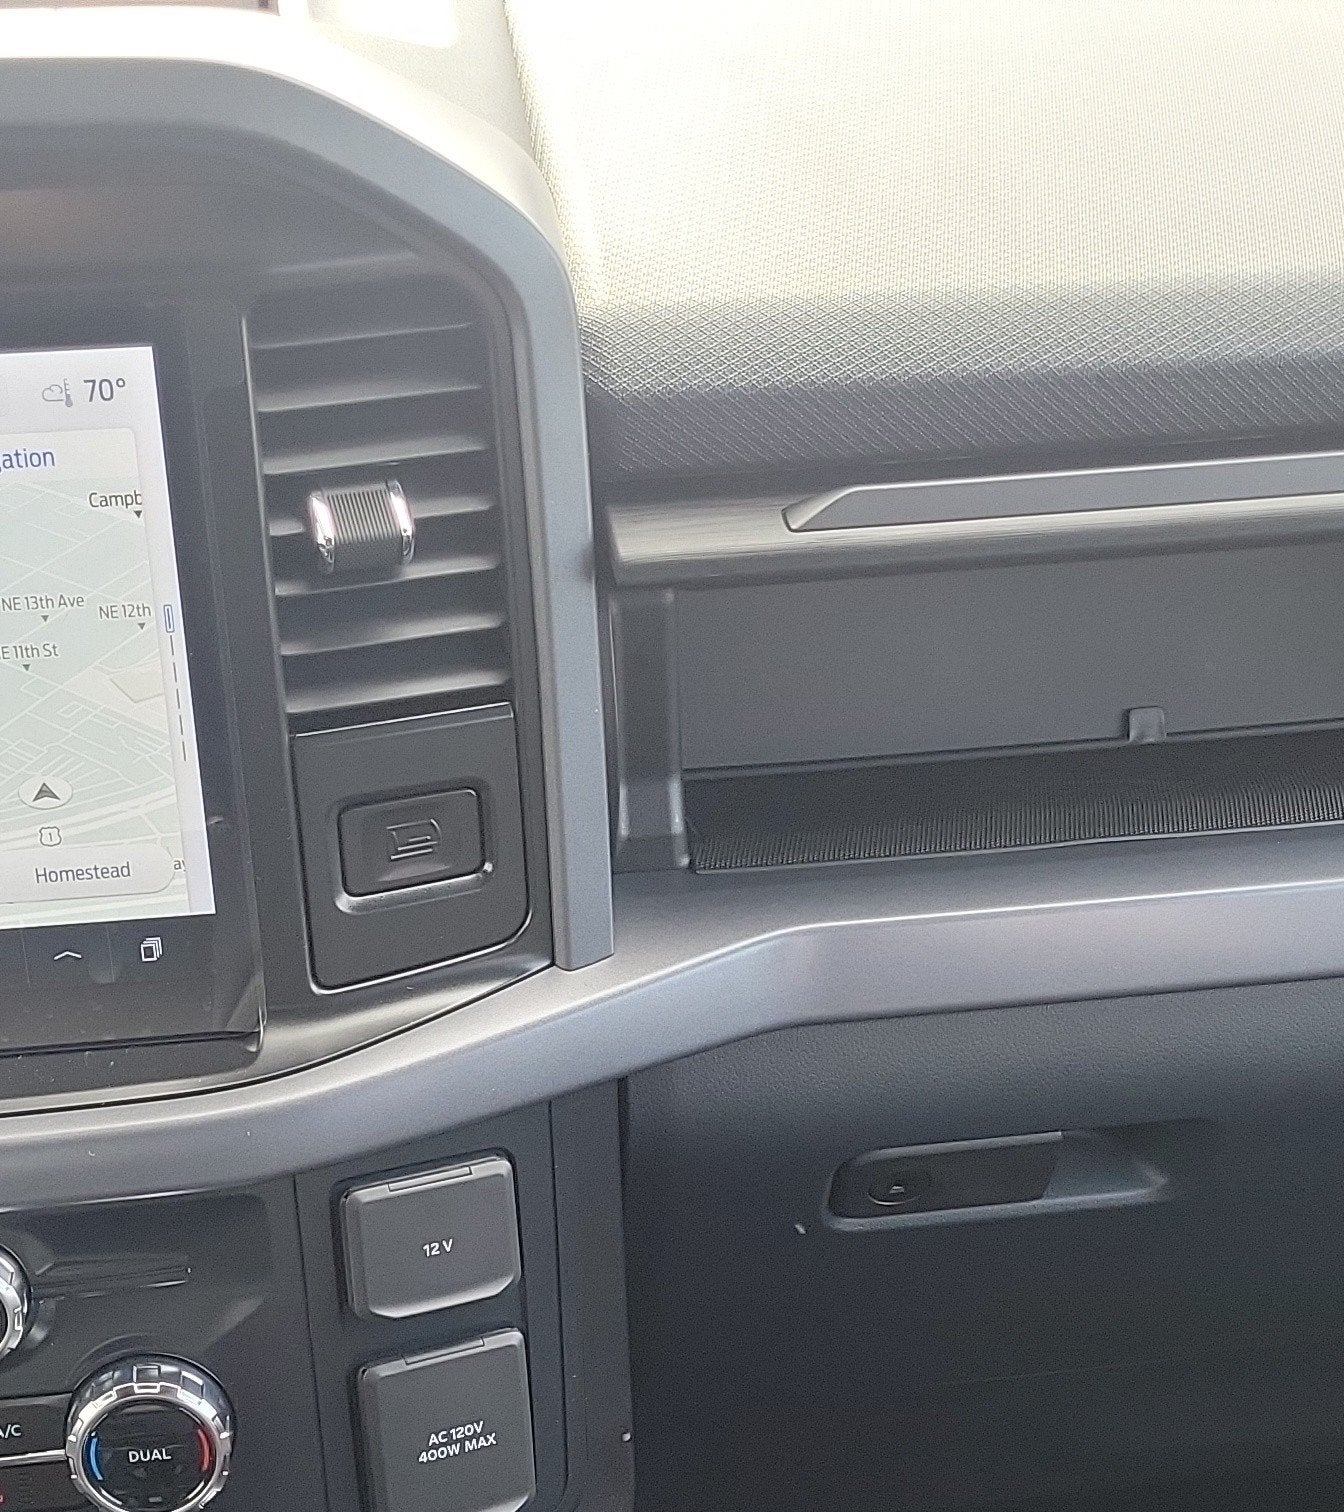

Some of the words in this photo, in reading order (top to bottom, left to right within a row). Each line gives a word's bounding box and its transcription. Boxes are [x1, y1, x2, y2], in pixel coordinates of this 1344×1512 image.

[83, 378, 126, 402] 70°
[1, 596, 22, 612] NE
[24, 594, 54, 610] 13th
[58, 594, 84, 608] Ave
[98, 605, 119, 620] NE
[121, 603, 152, 618] 12th
[13, 644, 40, 659] 11th
[43, 644, 59, 658] St
[35, 862, 131, 884] Homestead
[428, 1429, 448, 1447] AC
[450, 1420, 484, 1441] 120V
[128, 1448, 172, 1463] DUAL
[418, 1444, 460, 1464] 400W
[463, 1432, 497, 1453] MAX
